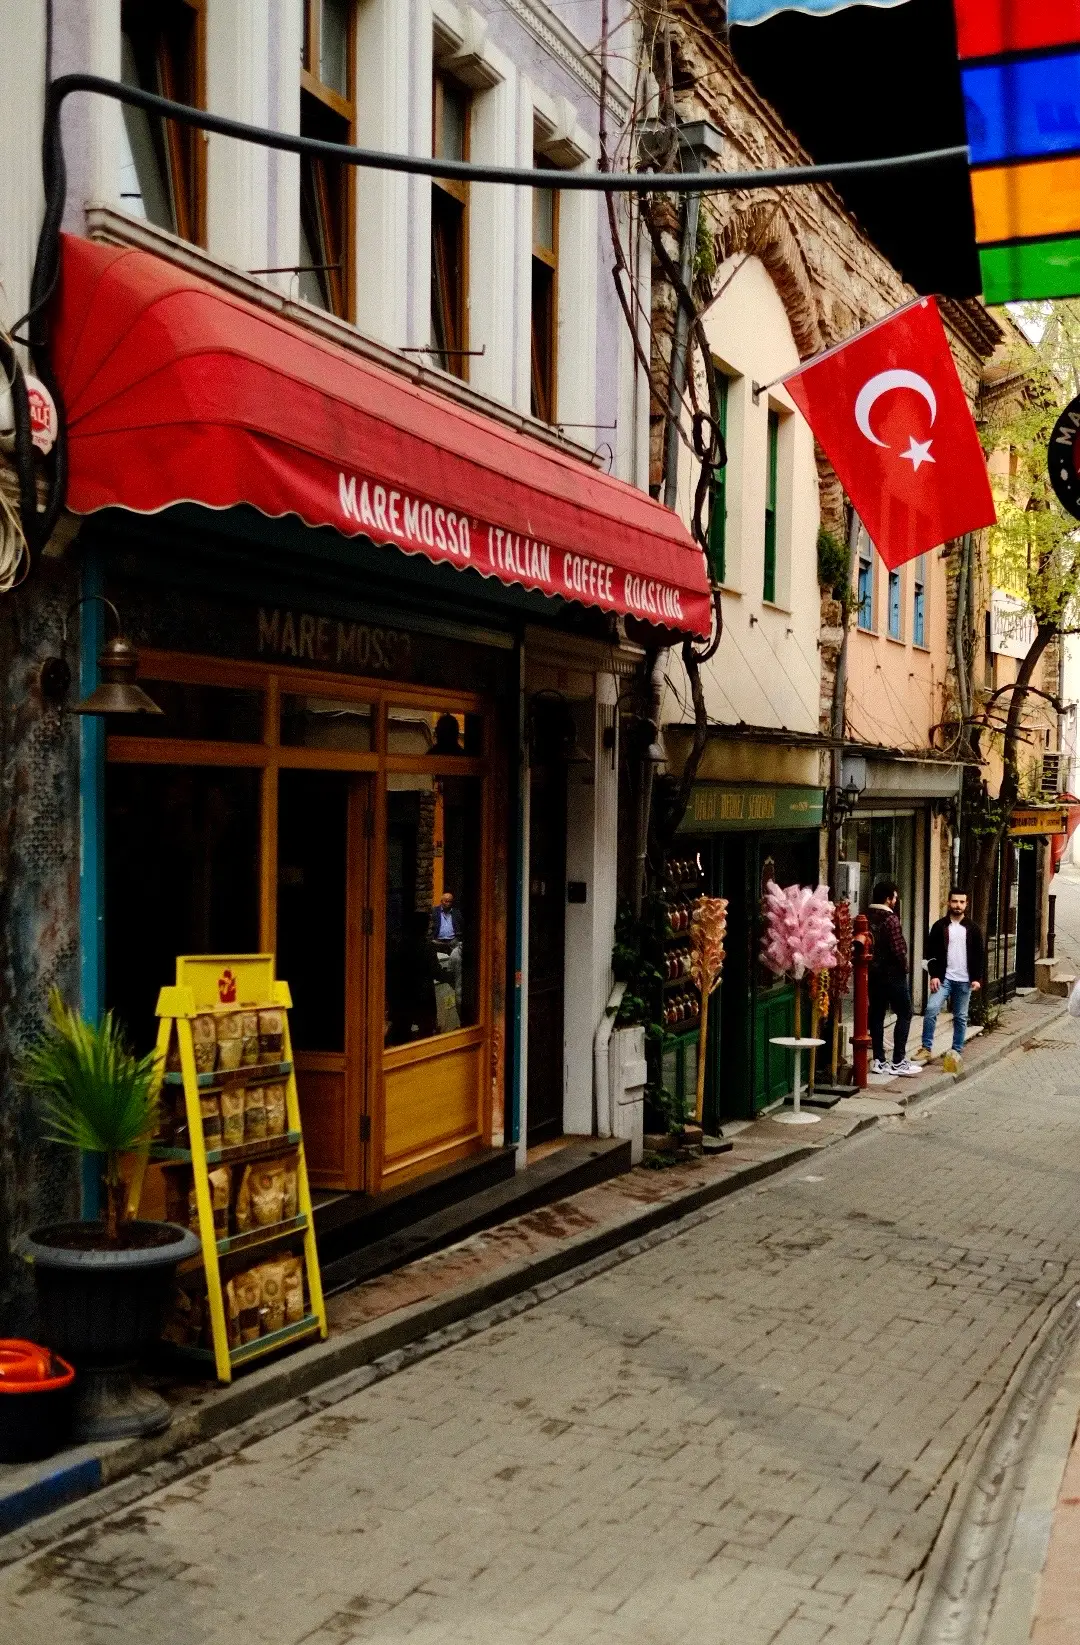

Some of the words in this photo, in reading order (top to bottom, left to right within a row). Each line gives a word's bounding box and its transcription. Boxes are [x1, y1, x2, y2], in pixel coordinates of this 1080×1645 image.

[338, 472, 471, 559] MAREMOSSO
[487, 525, 552, 583] ITALIAN
[563, 551, 615, 602] COFFEE
[624, 573, 684, 621] ROASTING
[258, 607, 330, 661] MARE
